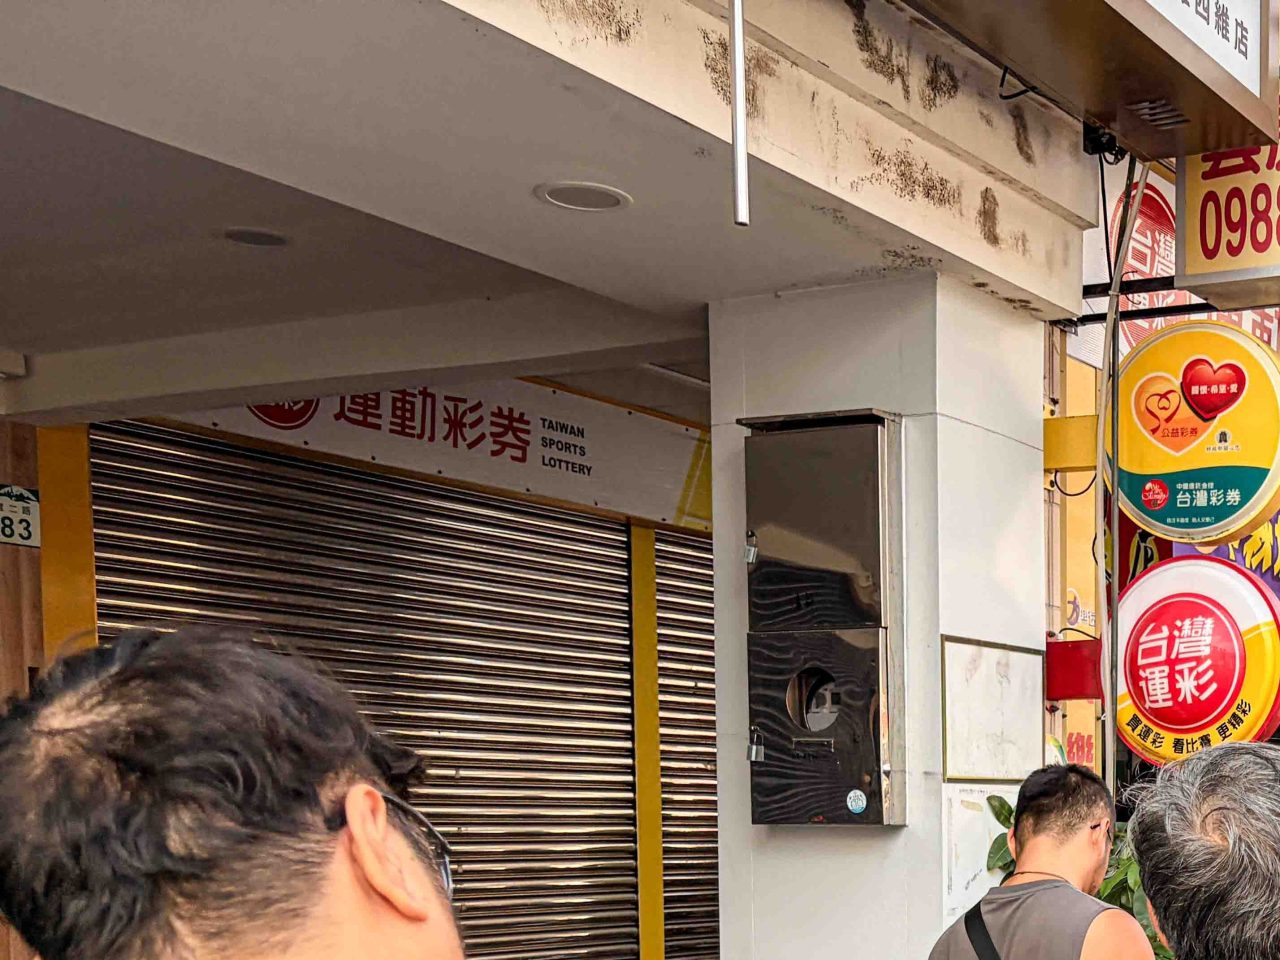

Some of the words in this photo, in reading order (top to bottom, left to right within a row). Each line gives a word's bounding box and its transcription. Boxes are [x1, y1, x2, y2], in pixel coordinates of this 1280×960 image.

[1181, 0, 1249, 60] 四維店
[333, 387, 532, 463] 運動彩券
[539, 416, 585, 439] TAIWAN
[1161, 427, 1198, 438] 公益彩券
[540, 436, 586, 458] SPORTS
[541, 454, 593, 477] LOTTERY
[1176, 488, 1241, 507] 台灣彩券
[1137, 616, 1215, 666] 台灣
[1138, 659, 1218, 709] 運彩
[1126, 713, 1165, 748] 買運彩
[1172, 734, 1212, 754] 看比賽
[1215, 699, 1251, 742] 更精彩
